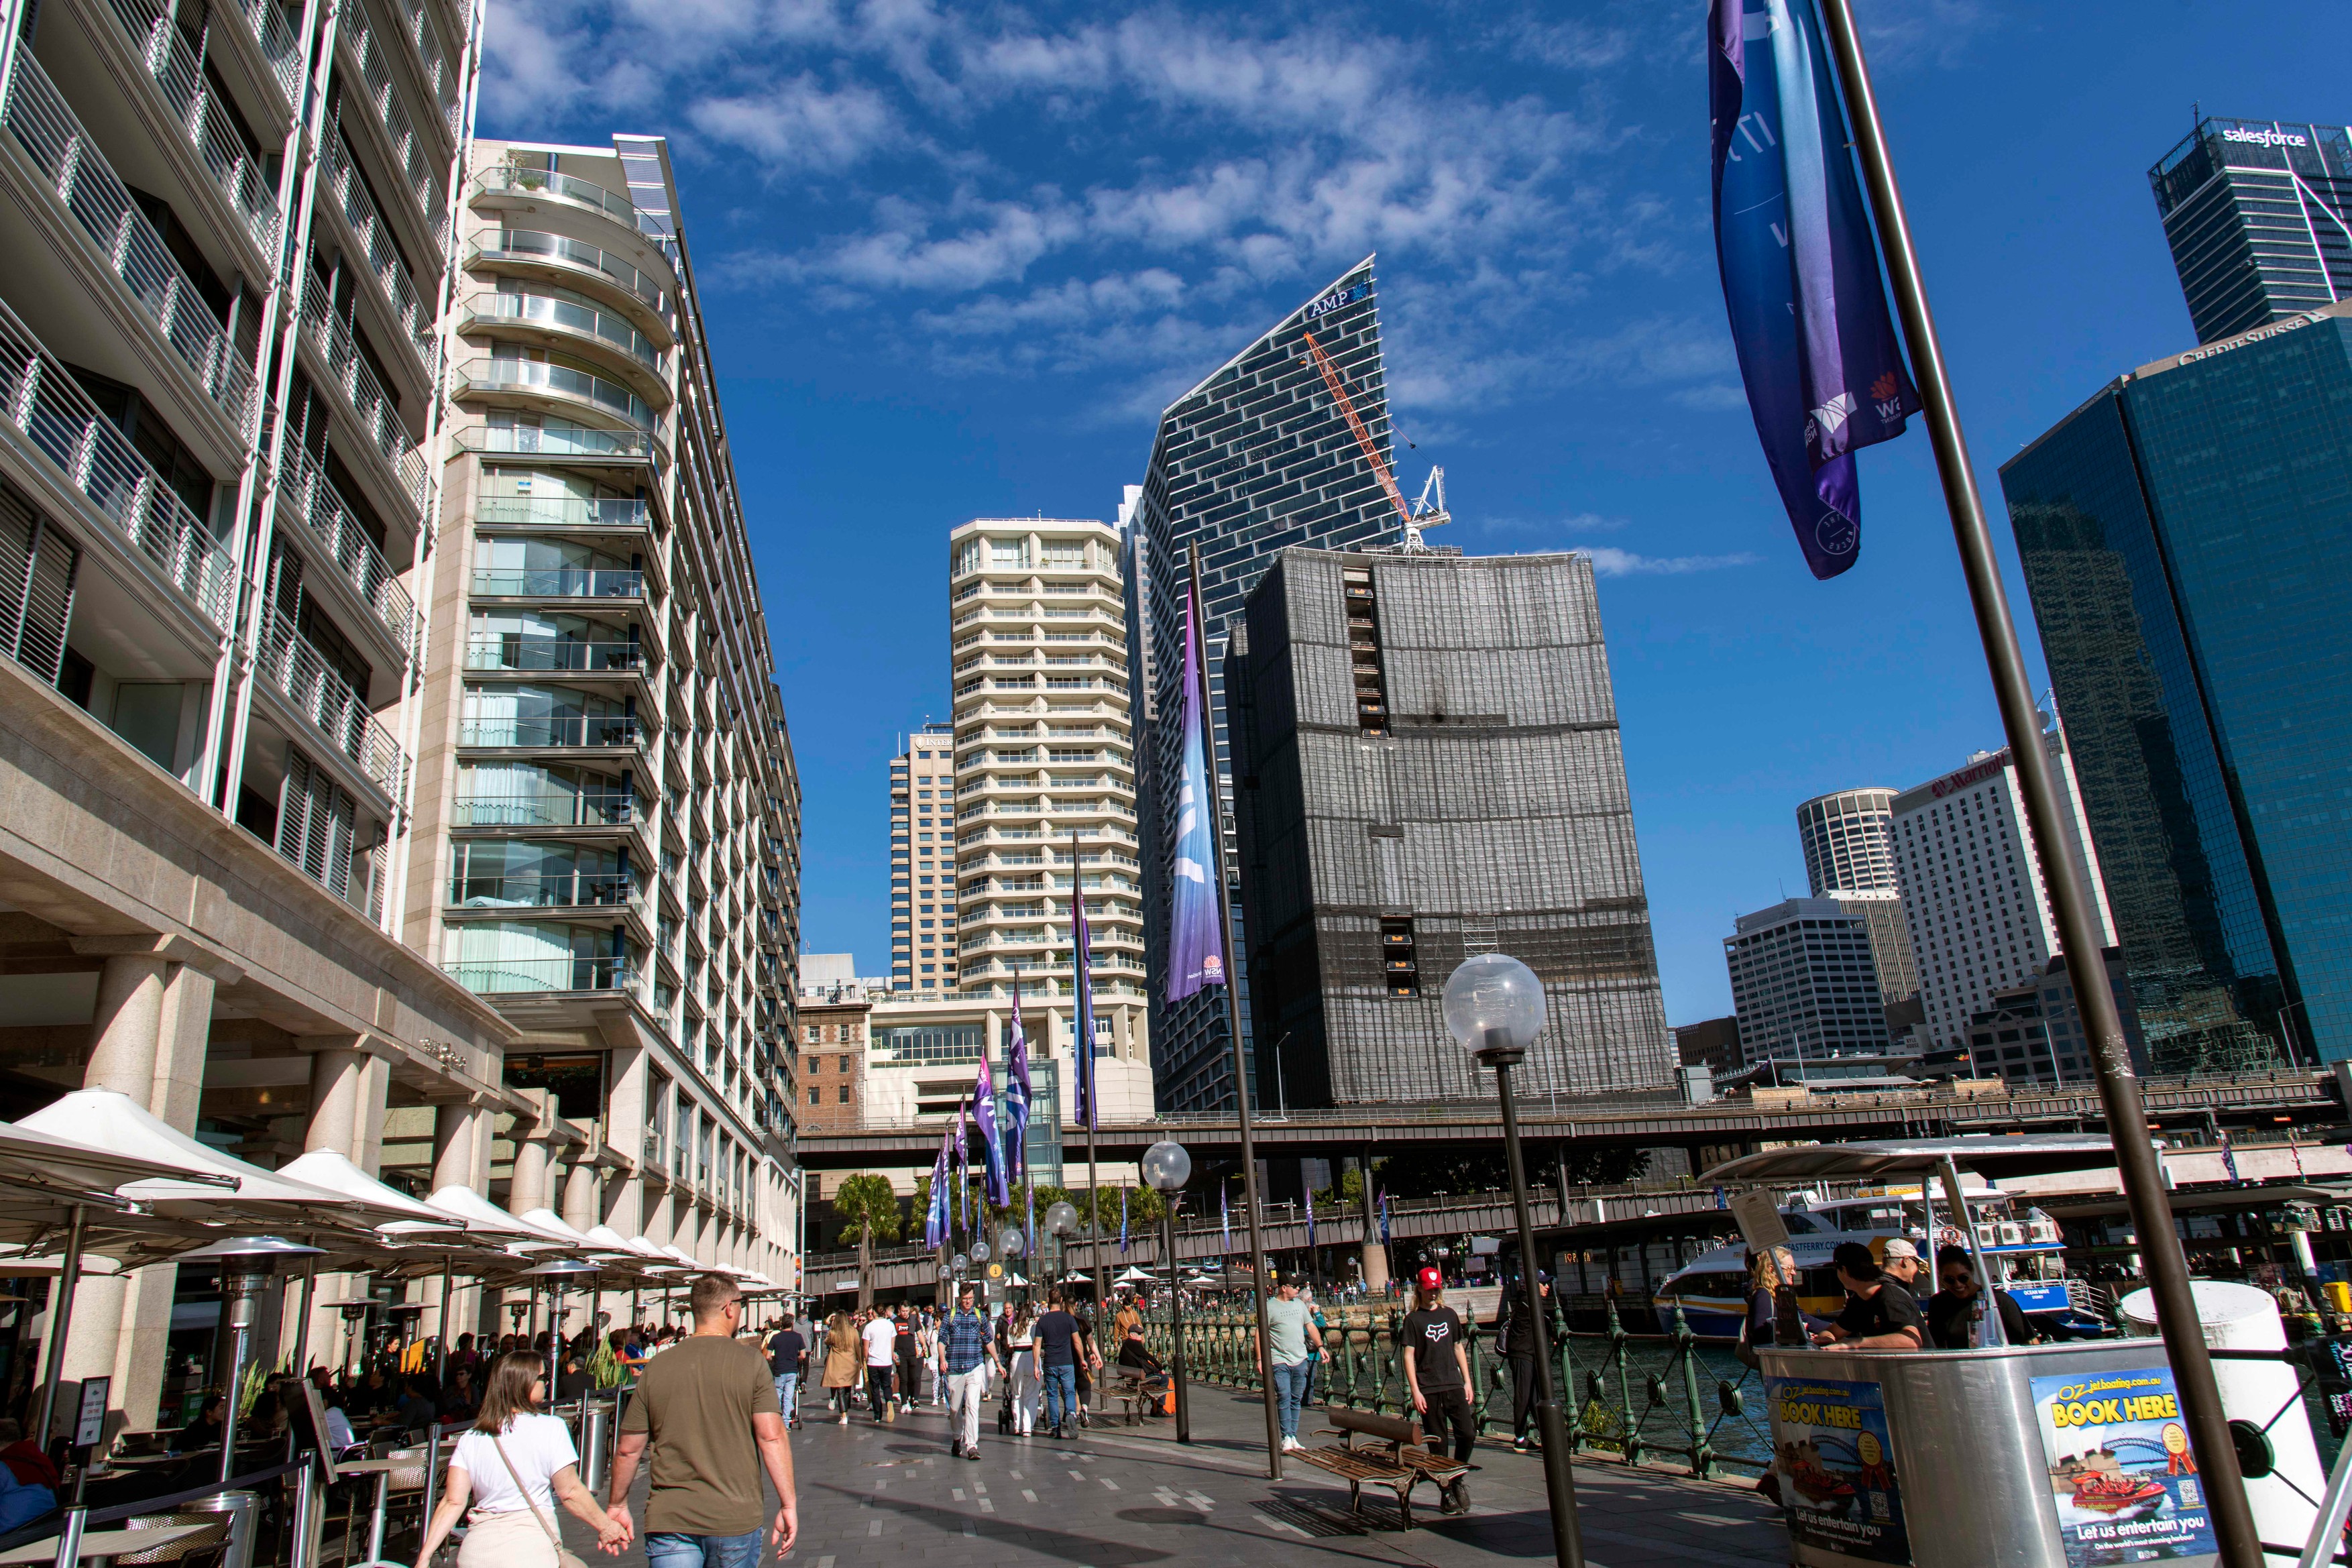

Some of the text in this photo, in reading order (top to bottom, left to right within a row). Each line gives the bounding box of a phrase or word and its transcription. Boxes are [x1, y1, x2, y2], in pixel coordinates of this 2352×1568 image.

[2222, 127, 2307, 149] salesforce
[1310, 290, 1349, 318] AMP
[2178, 318, 2305, 366] CREDIT SUISSE
[1948, 752, 2007, 793] Marriott
[1783, 1386, 1800, 1400] OZ
[2058, 1383, 2086, 1400] OZ
[1779, 1400, 1862, 1430] BOOK HERE
[2051, 1393, 2179, 1428] BOOK HERE
[1795, 1507, 1807, 1522] Let
[1808, 1513, 1818, 1525] us
[1818, 1515, 1859, 1533] entertain
[1859, 1523, 1882, 1538] you
[2076, 1515, 2206, 1541] Let us entertain you
[2094, 1543, 2105, 1551] On
[2104, 1541, 2114, 1549] the
[2134, 1538, 2149, 1547] most
[2148, 1536, 2172, 1546] stunning
